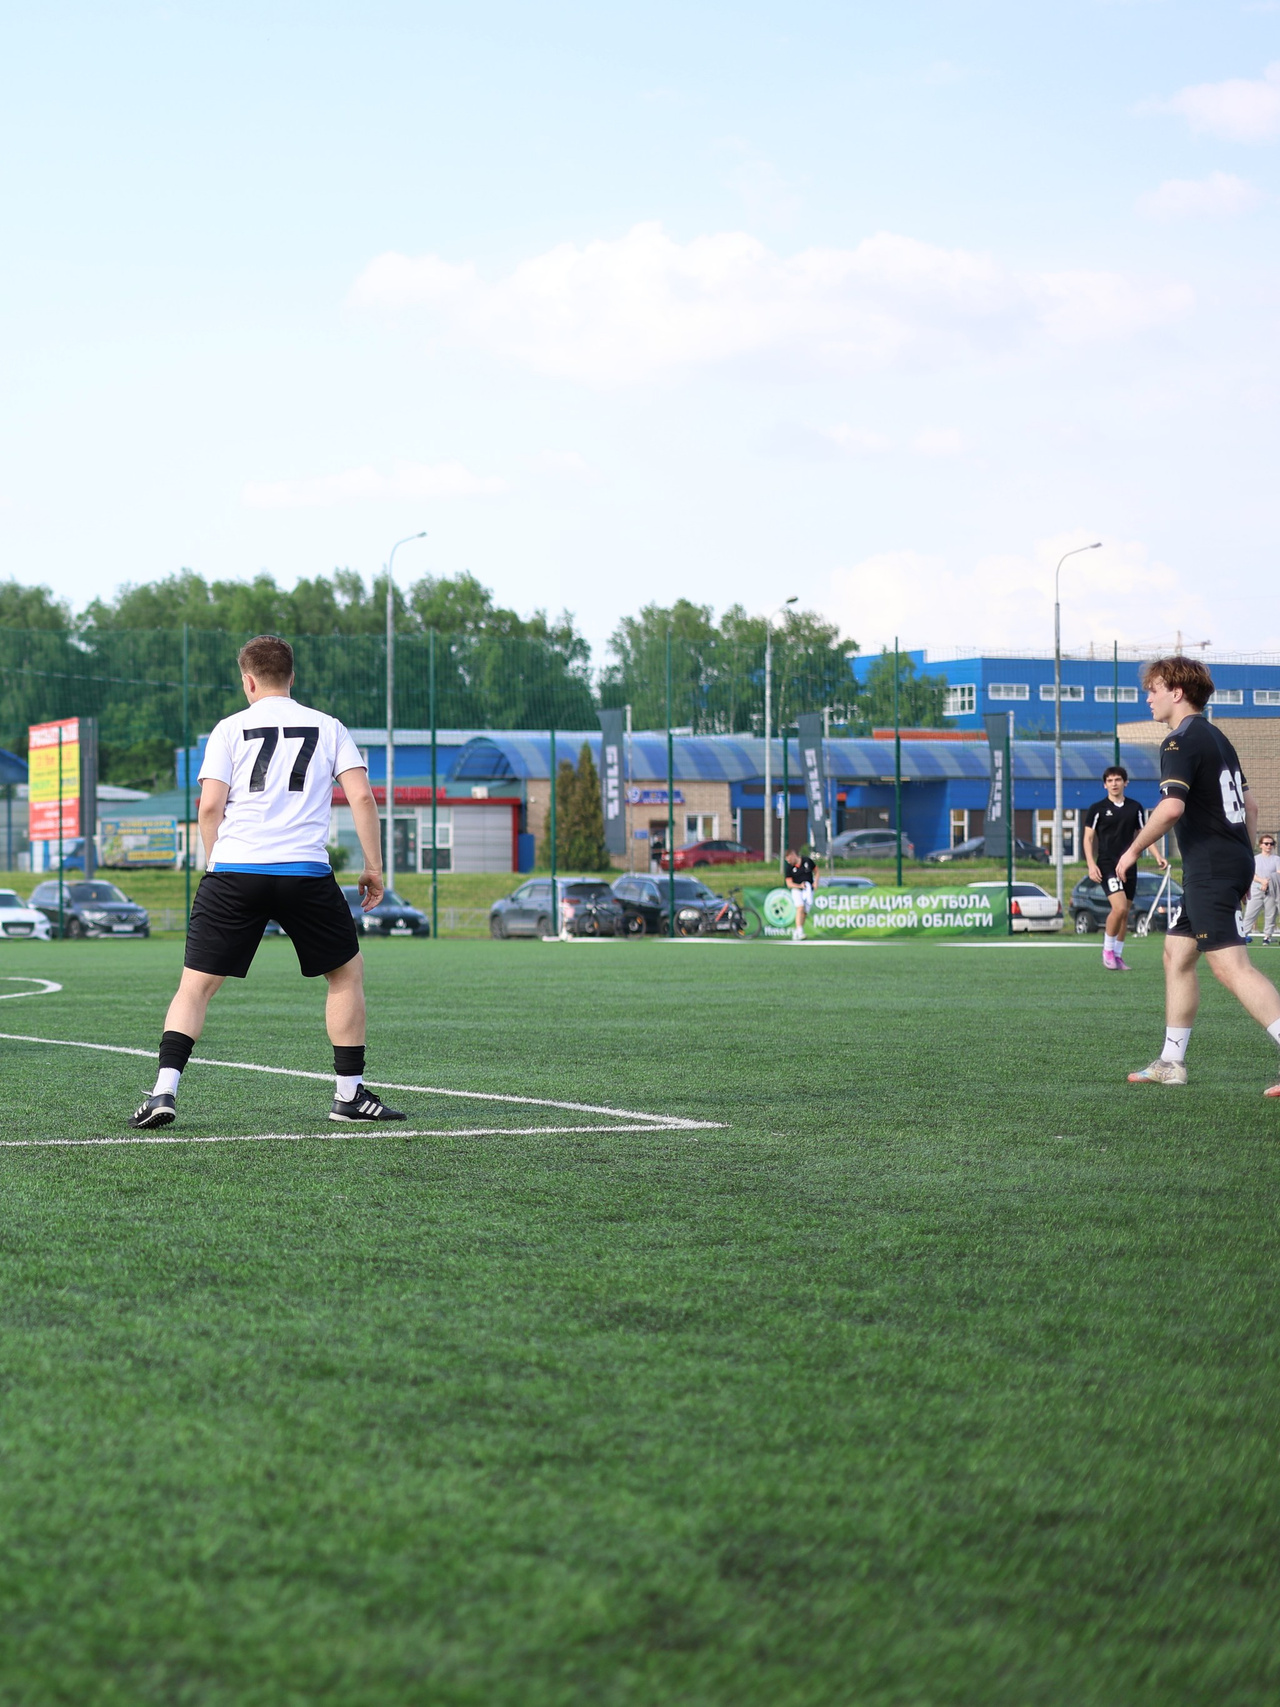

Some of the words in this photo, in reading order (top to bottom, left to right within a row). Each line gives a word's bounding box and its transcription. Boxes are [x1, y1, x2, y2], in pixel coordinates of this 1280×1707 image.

[243, 727, 319, 792] 77
[814, 895, 912, 912] ФЕДЕРАЦИЯ
[916, 894, 991, 910] ФУТБОЛА
[813, 910, 918, 929] МОСКОВСКОЙ
[922, 912, 993, 928] ОБЛАСТИ
